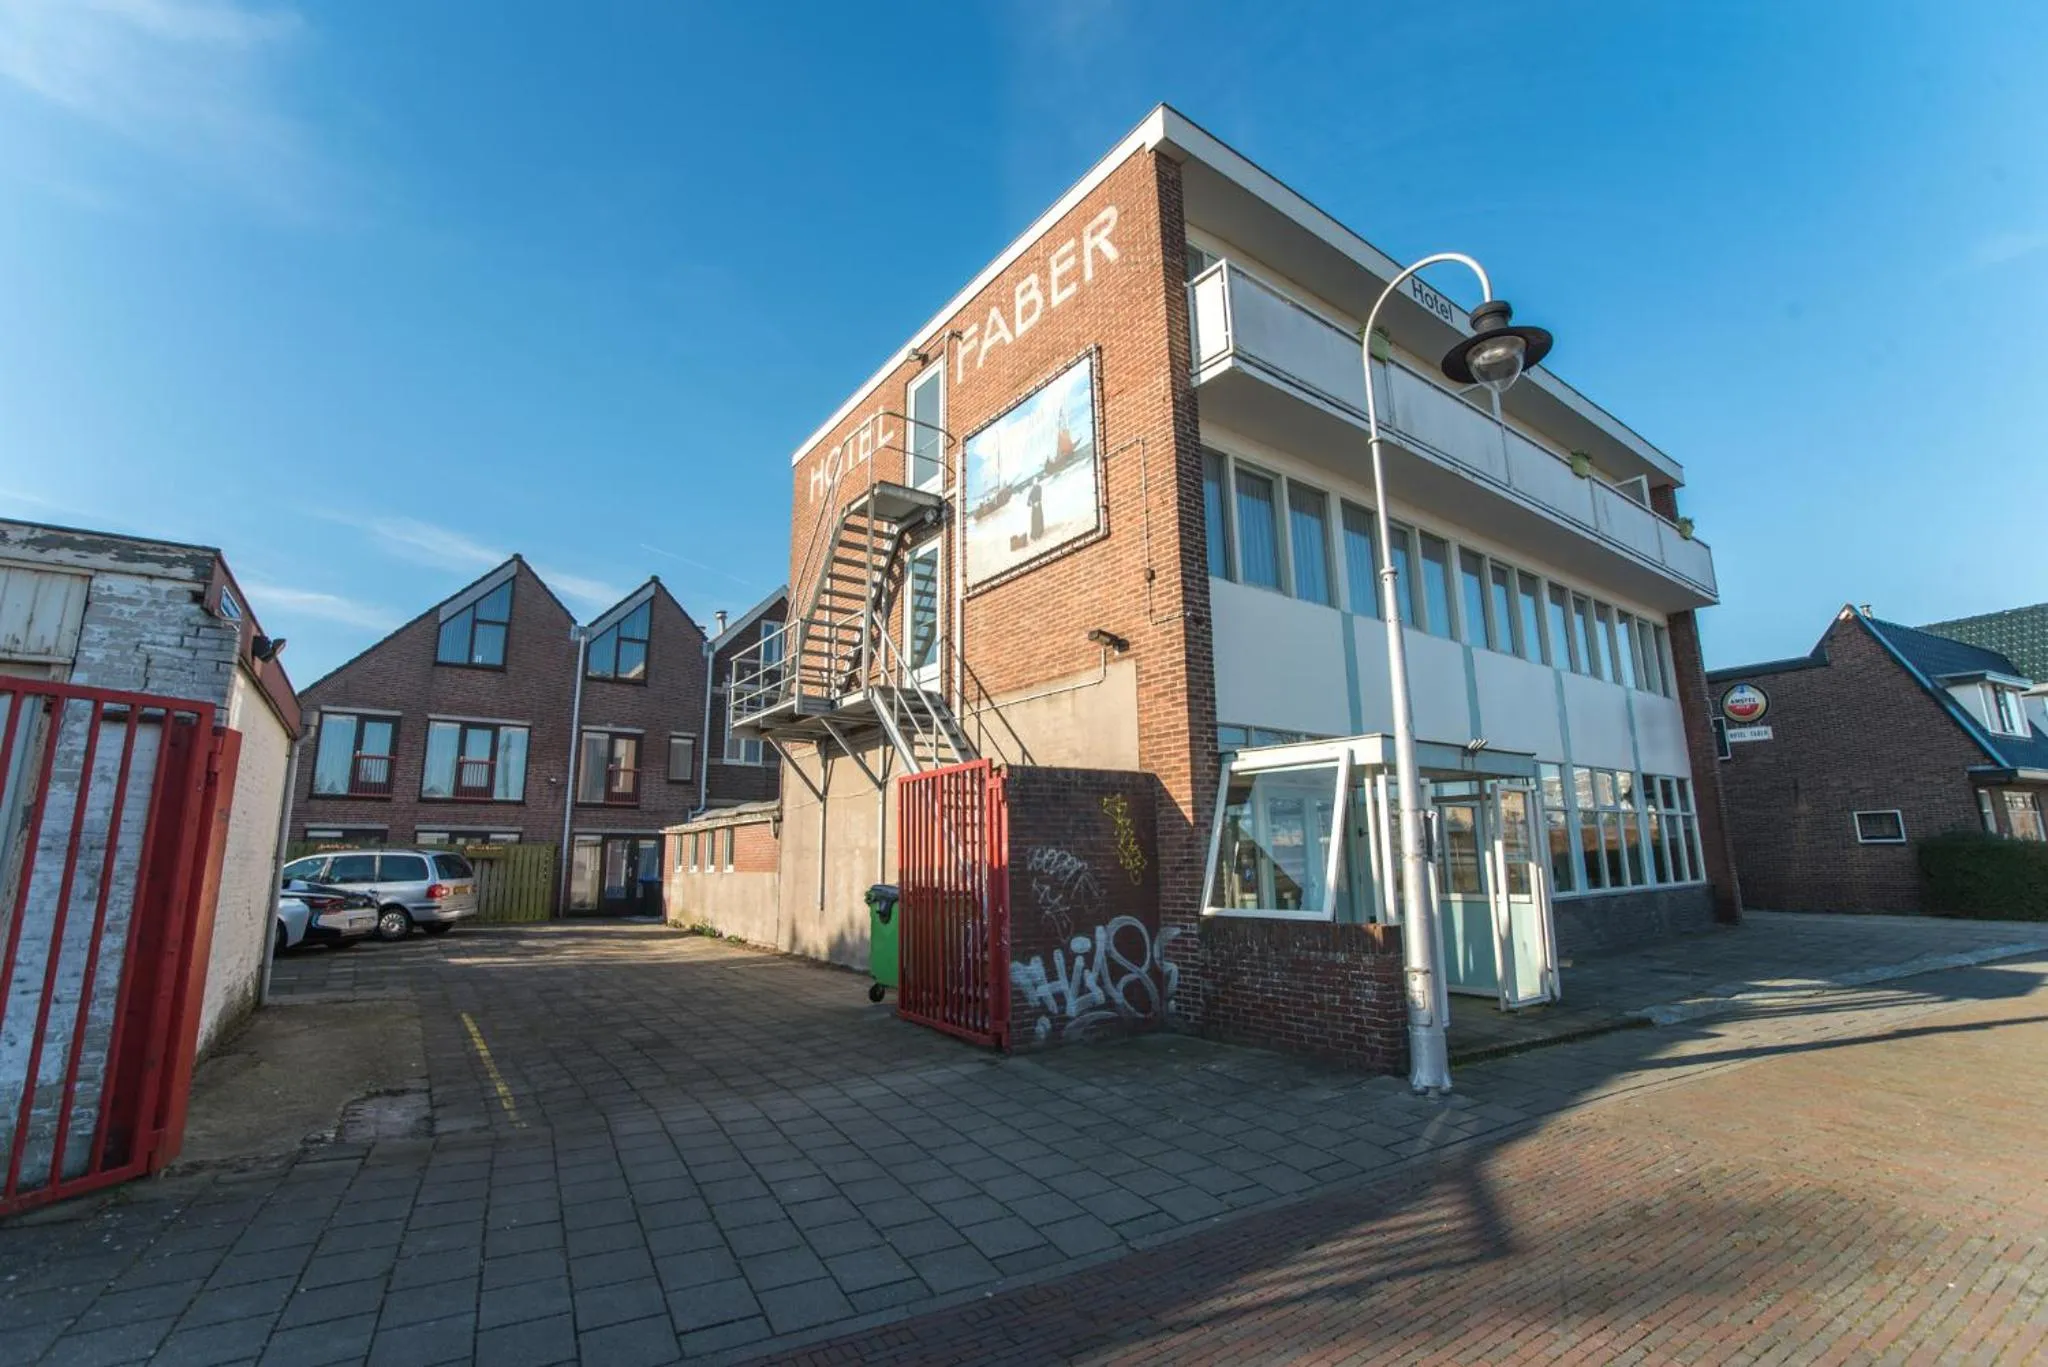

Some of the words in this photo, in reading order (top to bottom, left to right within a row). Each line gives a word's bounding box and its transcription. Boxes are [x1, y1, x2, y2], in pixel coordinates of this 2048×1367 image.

[809, 406, 894, 503] HOTEL
[956, 205, 1119, 385] FABER
[1411, 279, 1453, 323] Hotel
